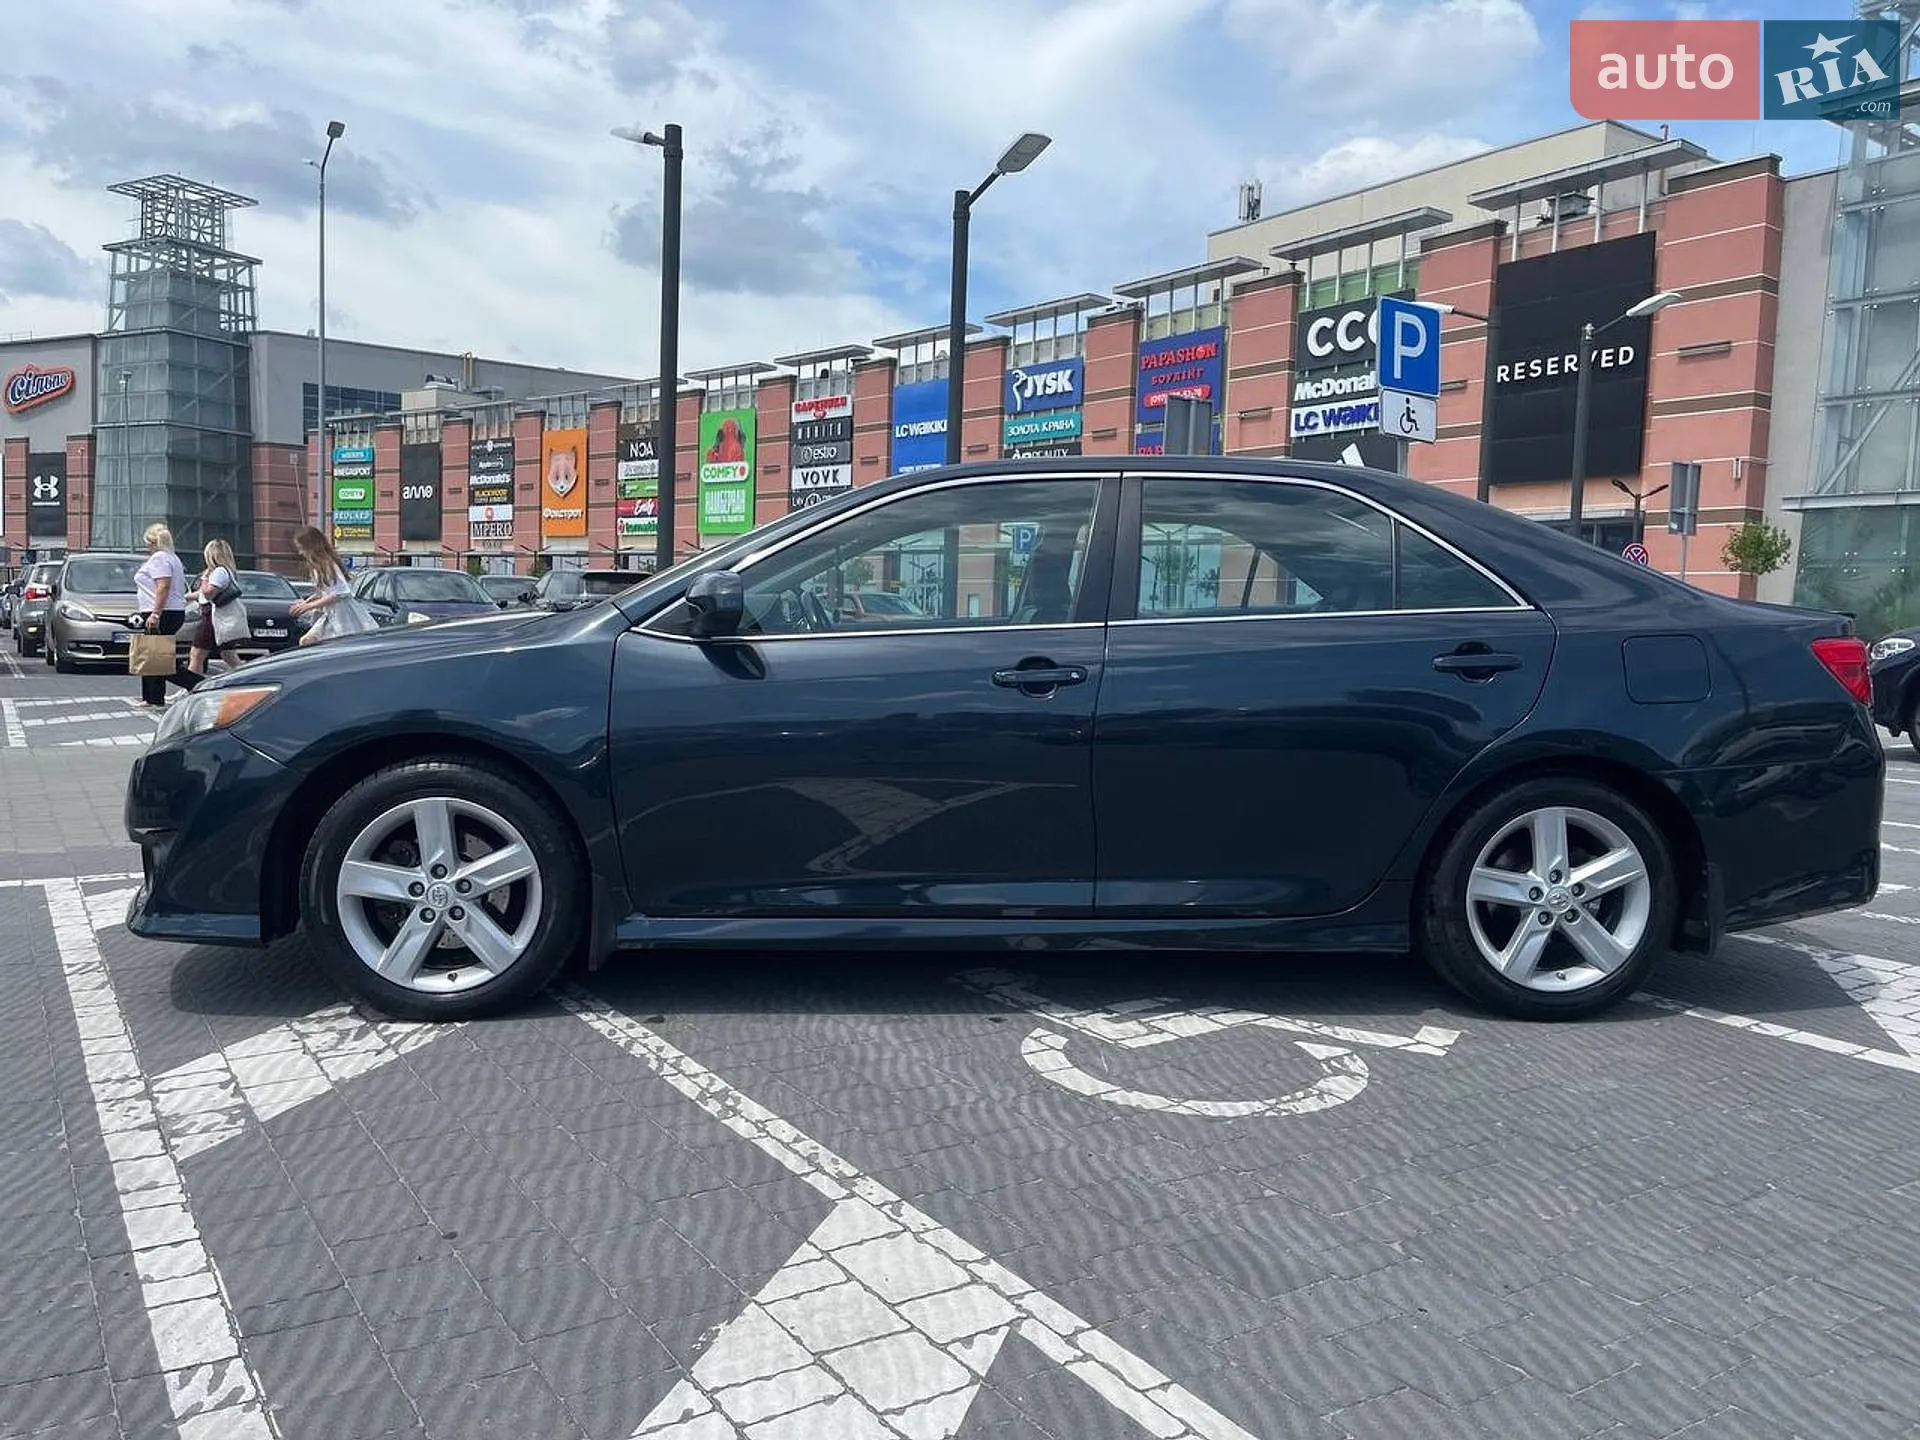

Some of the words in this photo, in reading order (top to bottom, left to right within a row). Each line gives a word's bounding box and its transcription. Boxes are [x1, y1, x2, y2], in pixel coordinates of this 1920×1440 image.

[1307, 309, 1377, 357] CC
[1394, 311, 1427, 380] P
[1141, 342, 1218, 371] PAPASHON
[1024, 369, 1074, 399] JYSK
[1007, 423, 1040, 437] ЗОЛОТА
[1041, 418, 1077, 433] КРАЇНА
[1294, 411, 1320, 432] LC
[703, 465, 739, 480] COMFY
